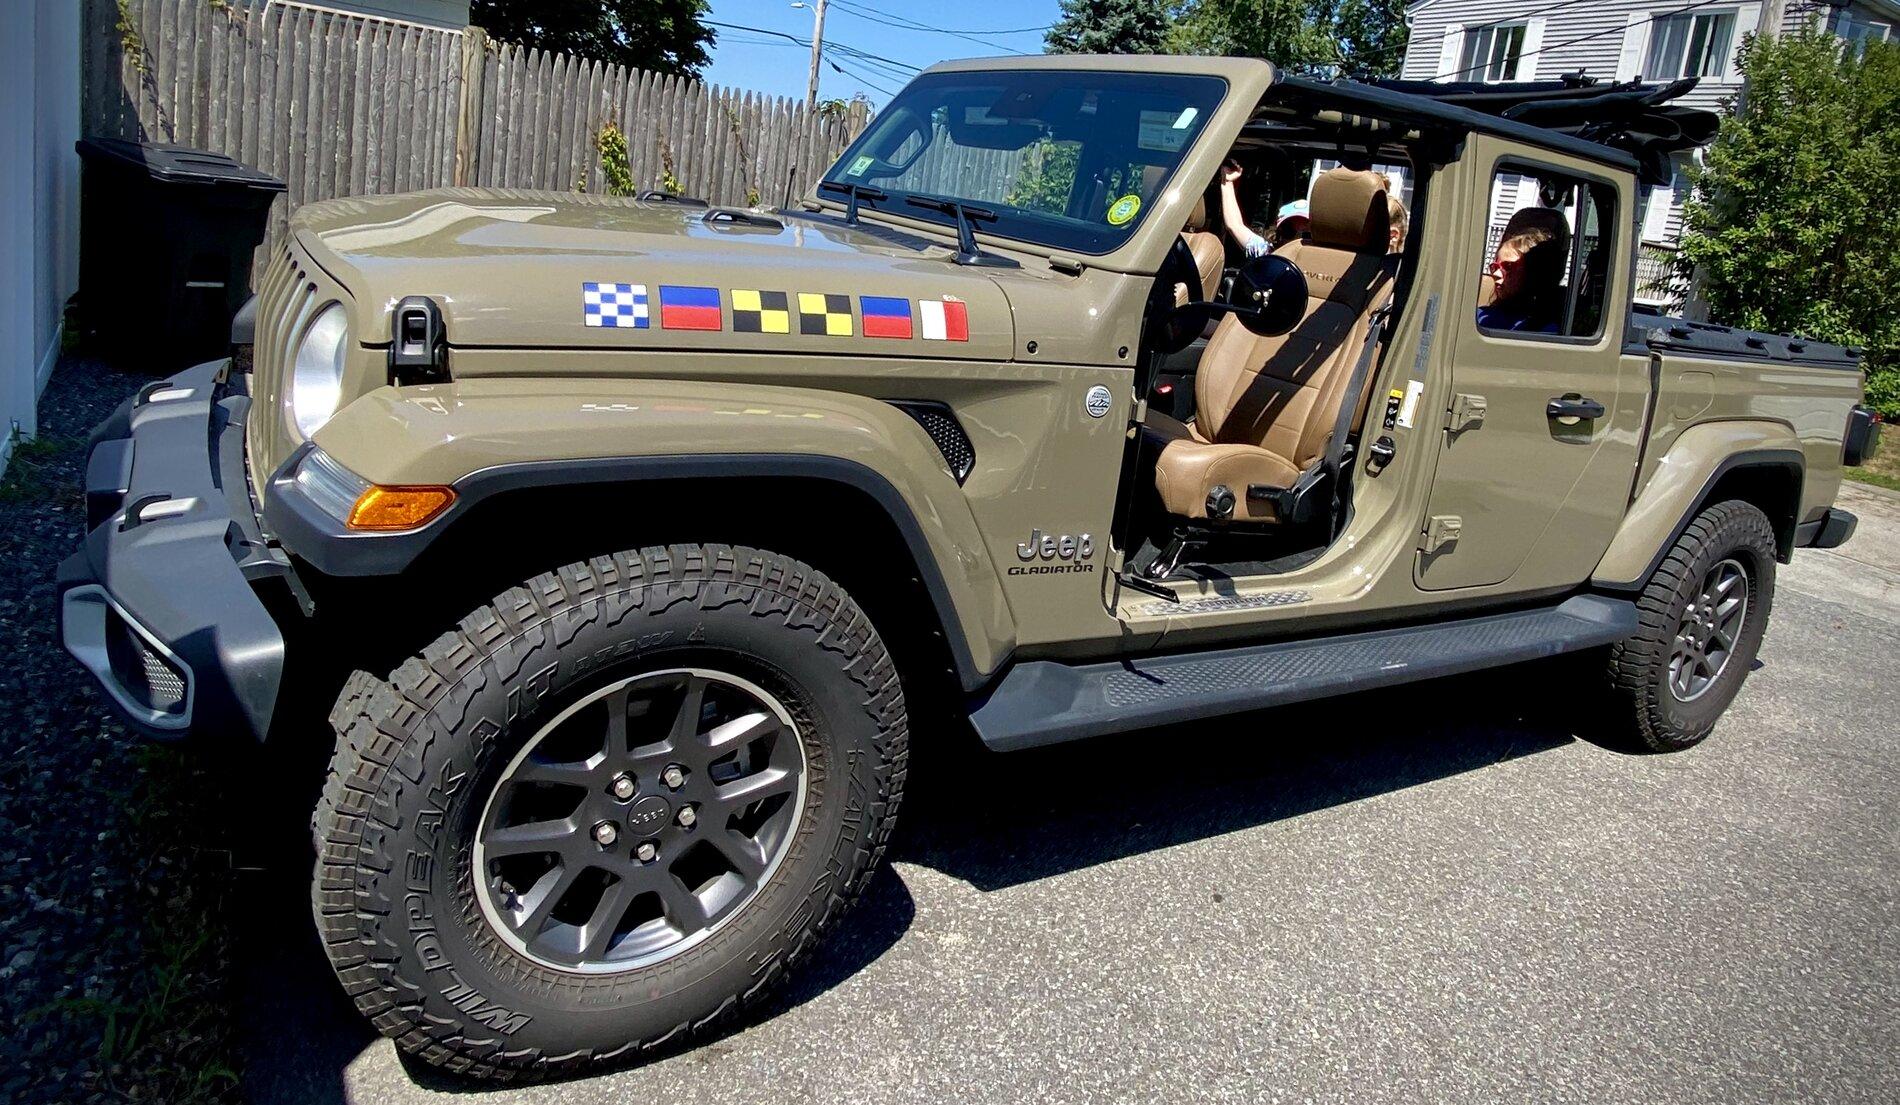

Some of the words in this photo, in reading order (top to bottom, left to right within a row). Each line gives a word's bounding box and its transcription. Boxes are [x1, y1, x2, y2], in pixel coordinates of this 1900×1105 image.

[1017, 528, 1096, 565] Jeep
[1007, 564, 1094, 576] GLADIATOR
[404, 757, 534, 1036] WILDPEAK
